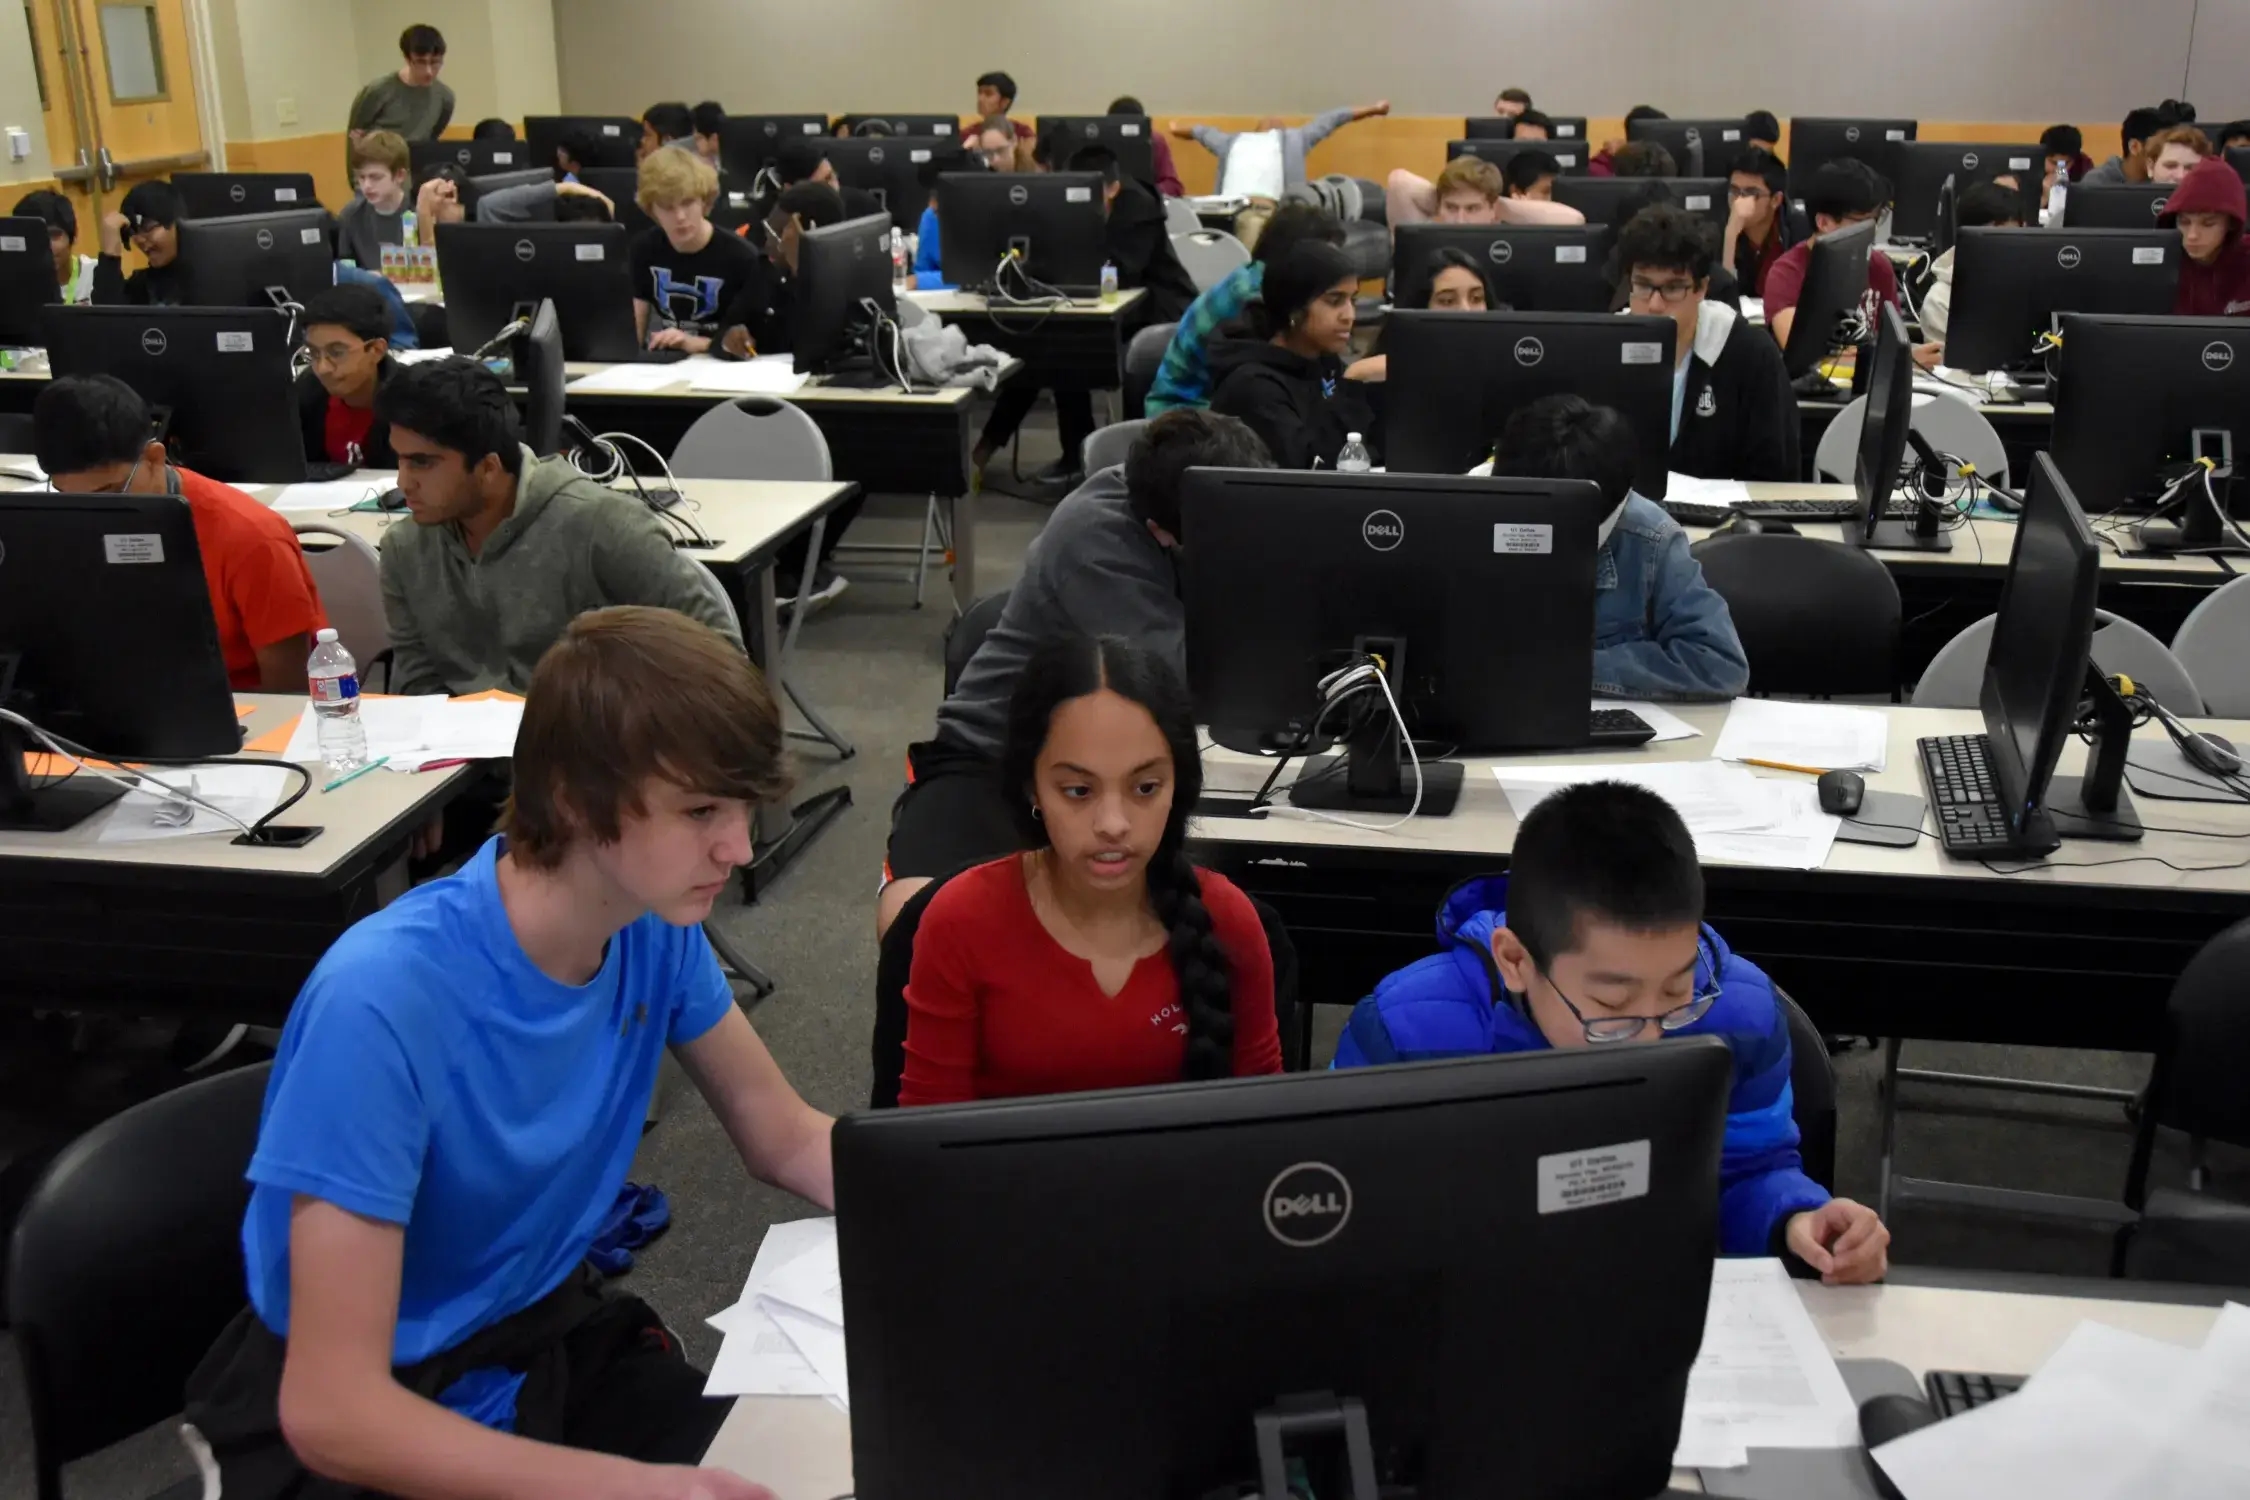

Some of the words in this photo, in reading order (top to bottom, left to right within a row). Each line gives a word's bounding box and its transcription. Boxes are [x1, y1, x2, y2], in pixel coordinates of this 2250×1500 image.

[1518, 346, 1541, 356] DELL
[2206, 352, 2229, 360] DELL
[1368, 525, 1400, 536] DELL
[1274, 1192, 1343, 1217] DELL
